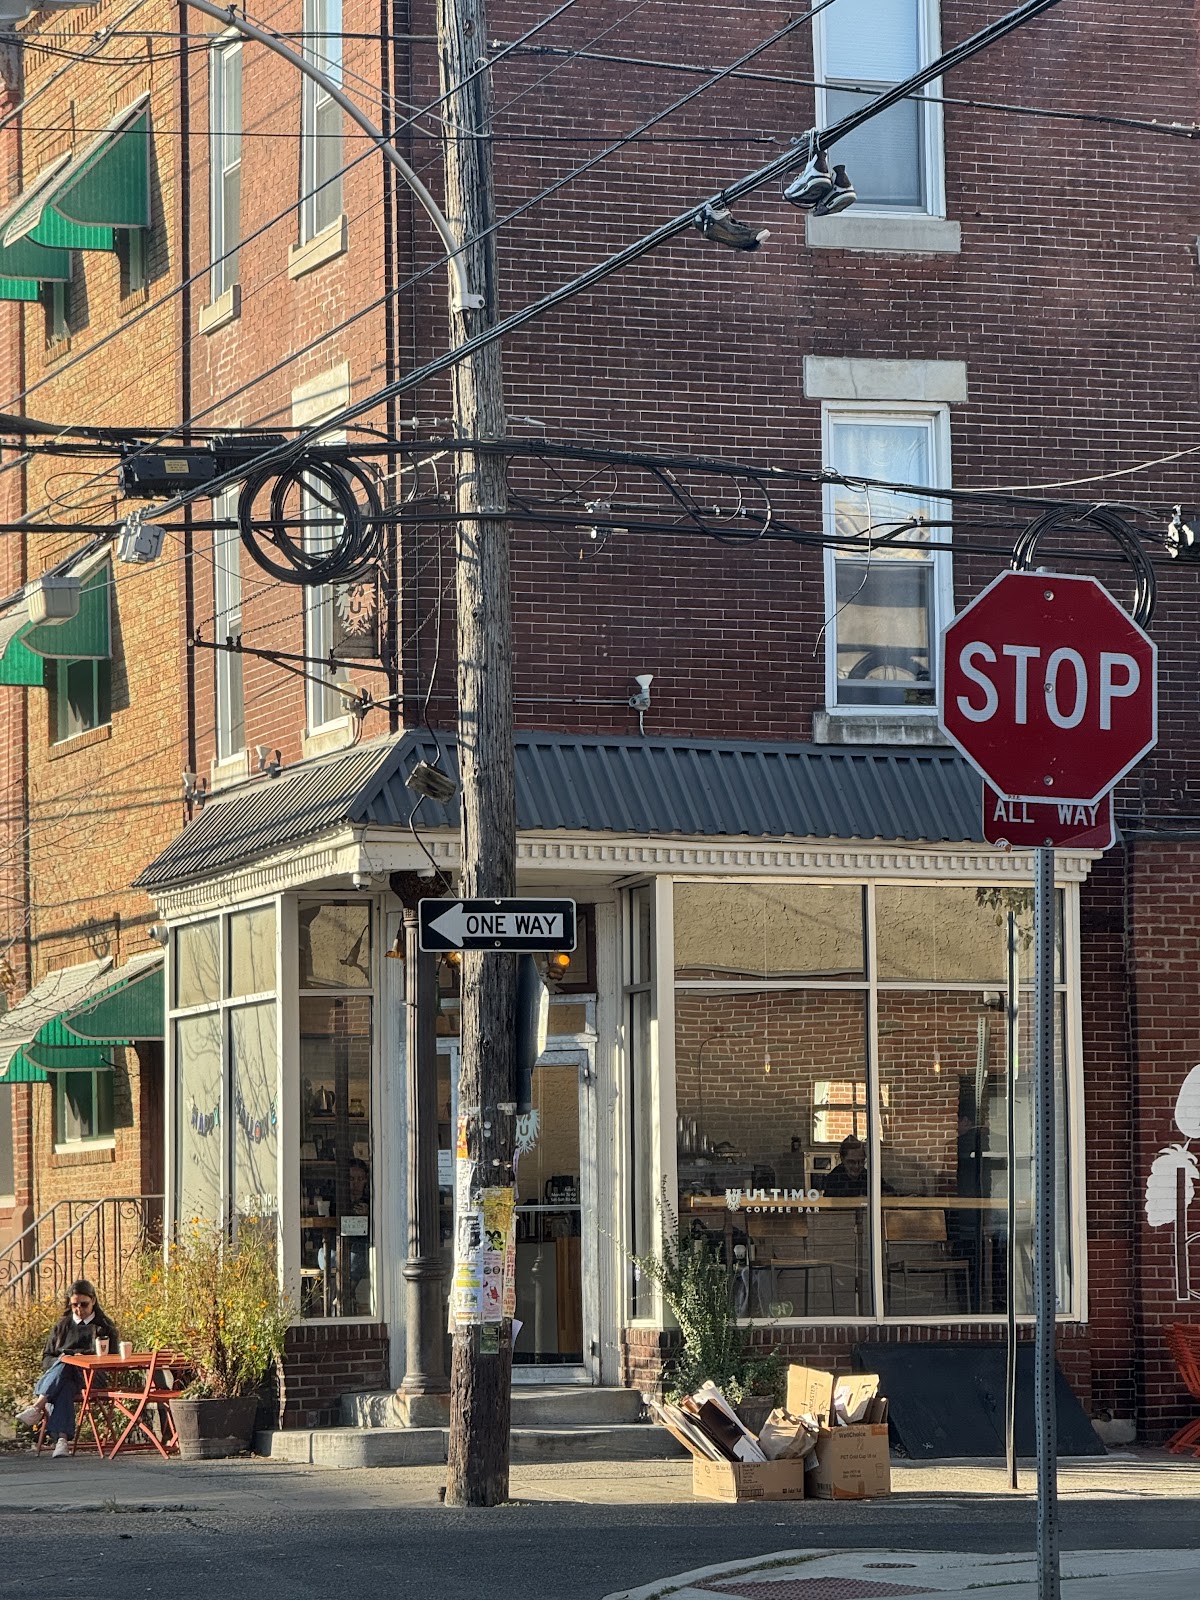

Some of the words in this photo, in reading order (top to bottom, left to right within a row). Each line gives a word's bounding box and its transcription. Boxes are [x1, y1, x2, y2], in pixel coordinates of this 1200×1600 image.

[350, 601, 361, 614] U
[957, 641, 1141, 730] STOP
[993, 798, 1035, 824] ALL
[1057, 802, 1101, 827] WAY
[466, 915, 507, 934] ONE
[515, 915, 557, 935] WAY
[520, 1124, 529, 1136] U
[746, 1188, 820, 1202] ULTIMO
